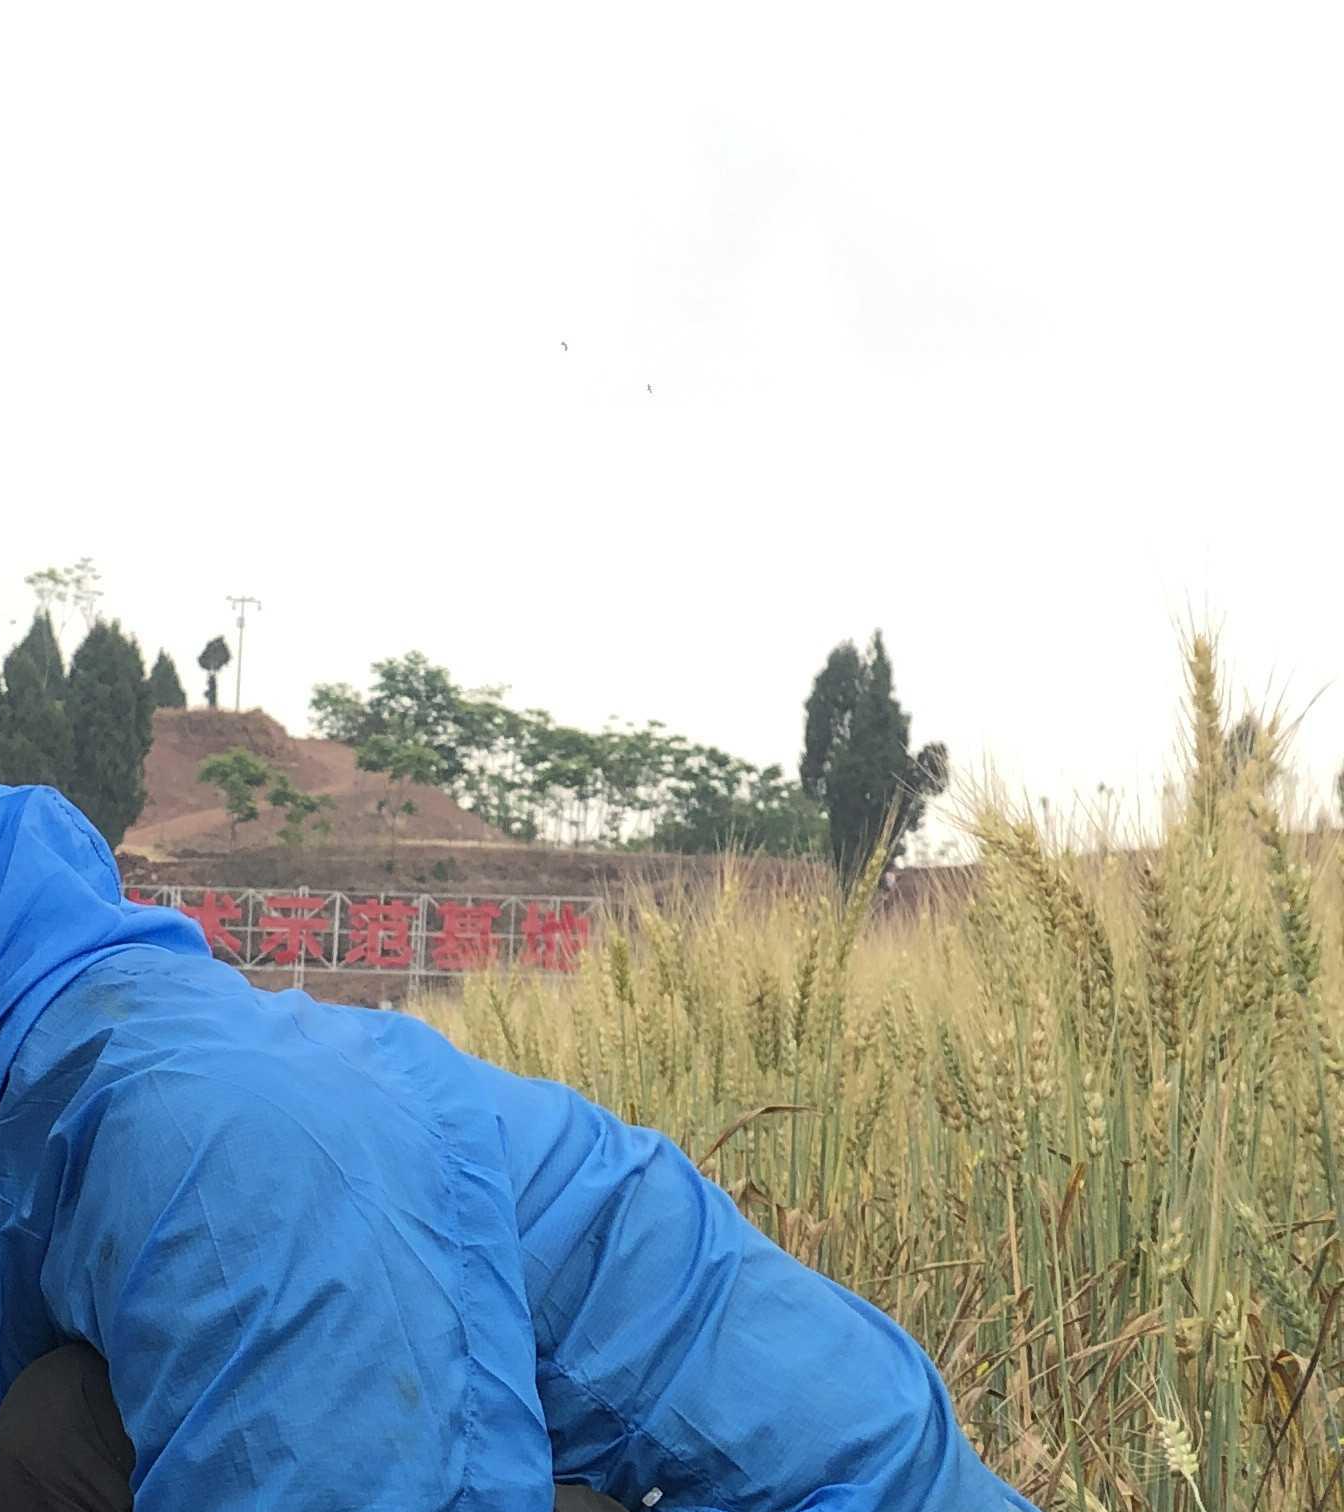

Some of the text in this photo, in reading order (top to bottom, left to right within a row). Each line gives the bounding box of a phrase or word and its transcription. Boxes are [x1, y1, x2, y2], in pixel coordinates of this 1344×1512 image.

[128, 887, 591, 972] 术示范基地
